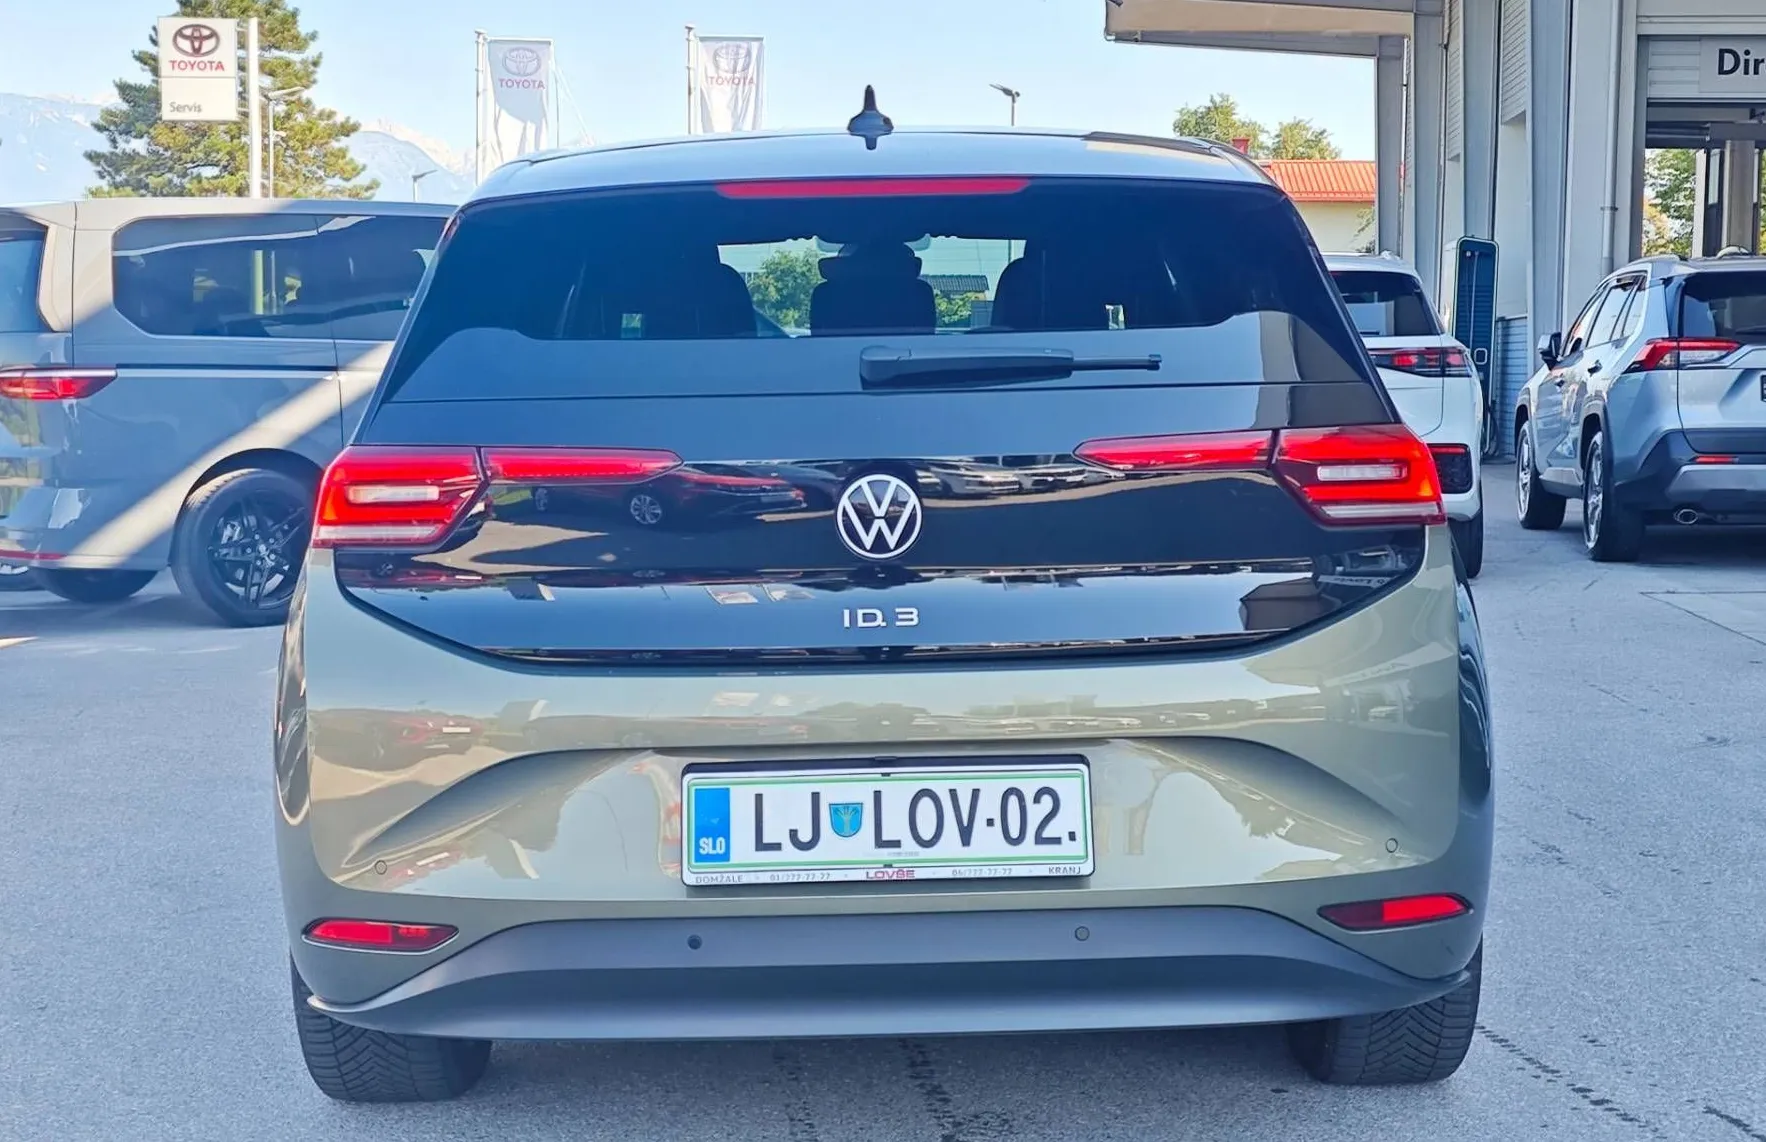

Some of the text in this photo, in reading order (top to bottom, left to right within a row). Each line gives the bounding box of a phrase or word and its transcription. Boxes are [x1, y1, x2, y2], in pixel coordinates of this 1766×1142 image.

[168, 60, 225, 71] TOYOTA
[1718, 48, 1766, 76] Dir
[499, 78, 546, 90] TOYOTA
[709, 75, 755, 86] TOYOTA
[169, 101, 203, 113] Servis
[838, 474, 922, 558] VW
[699, 836, 726, 855] SLO
[754, 791, 821, 852] LJ
[866, 869, 915, 880] LOVŠE
[1048, 866, 1081, 875] KRANJ
